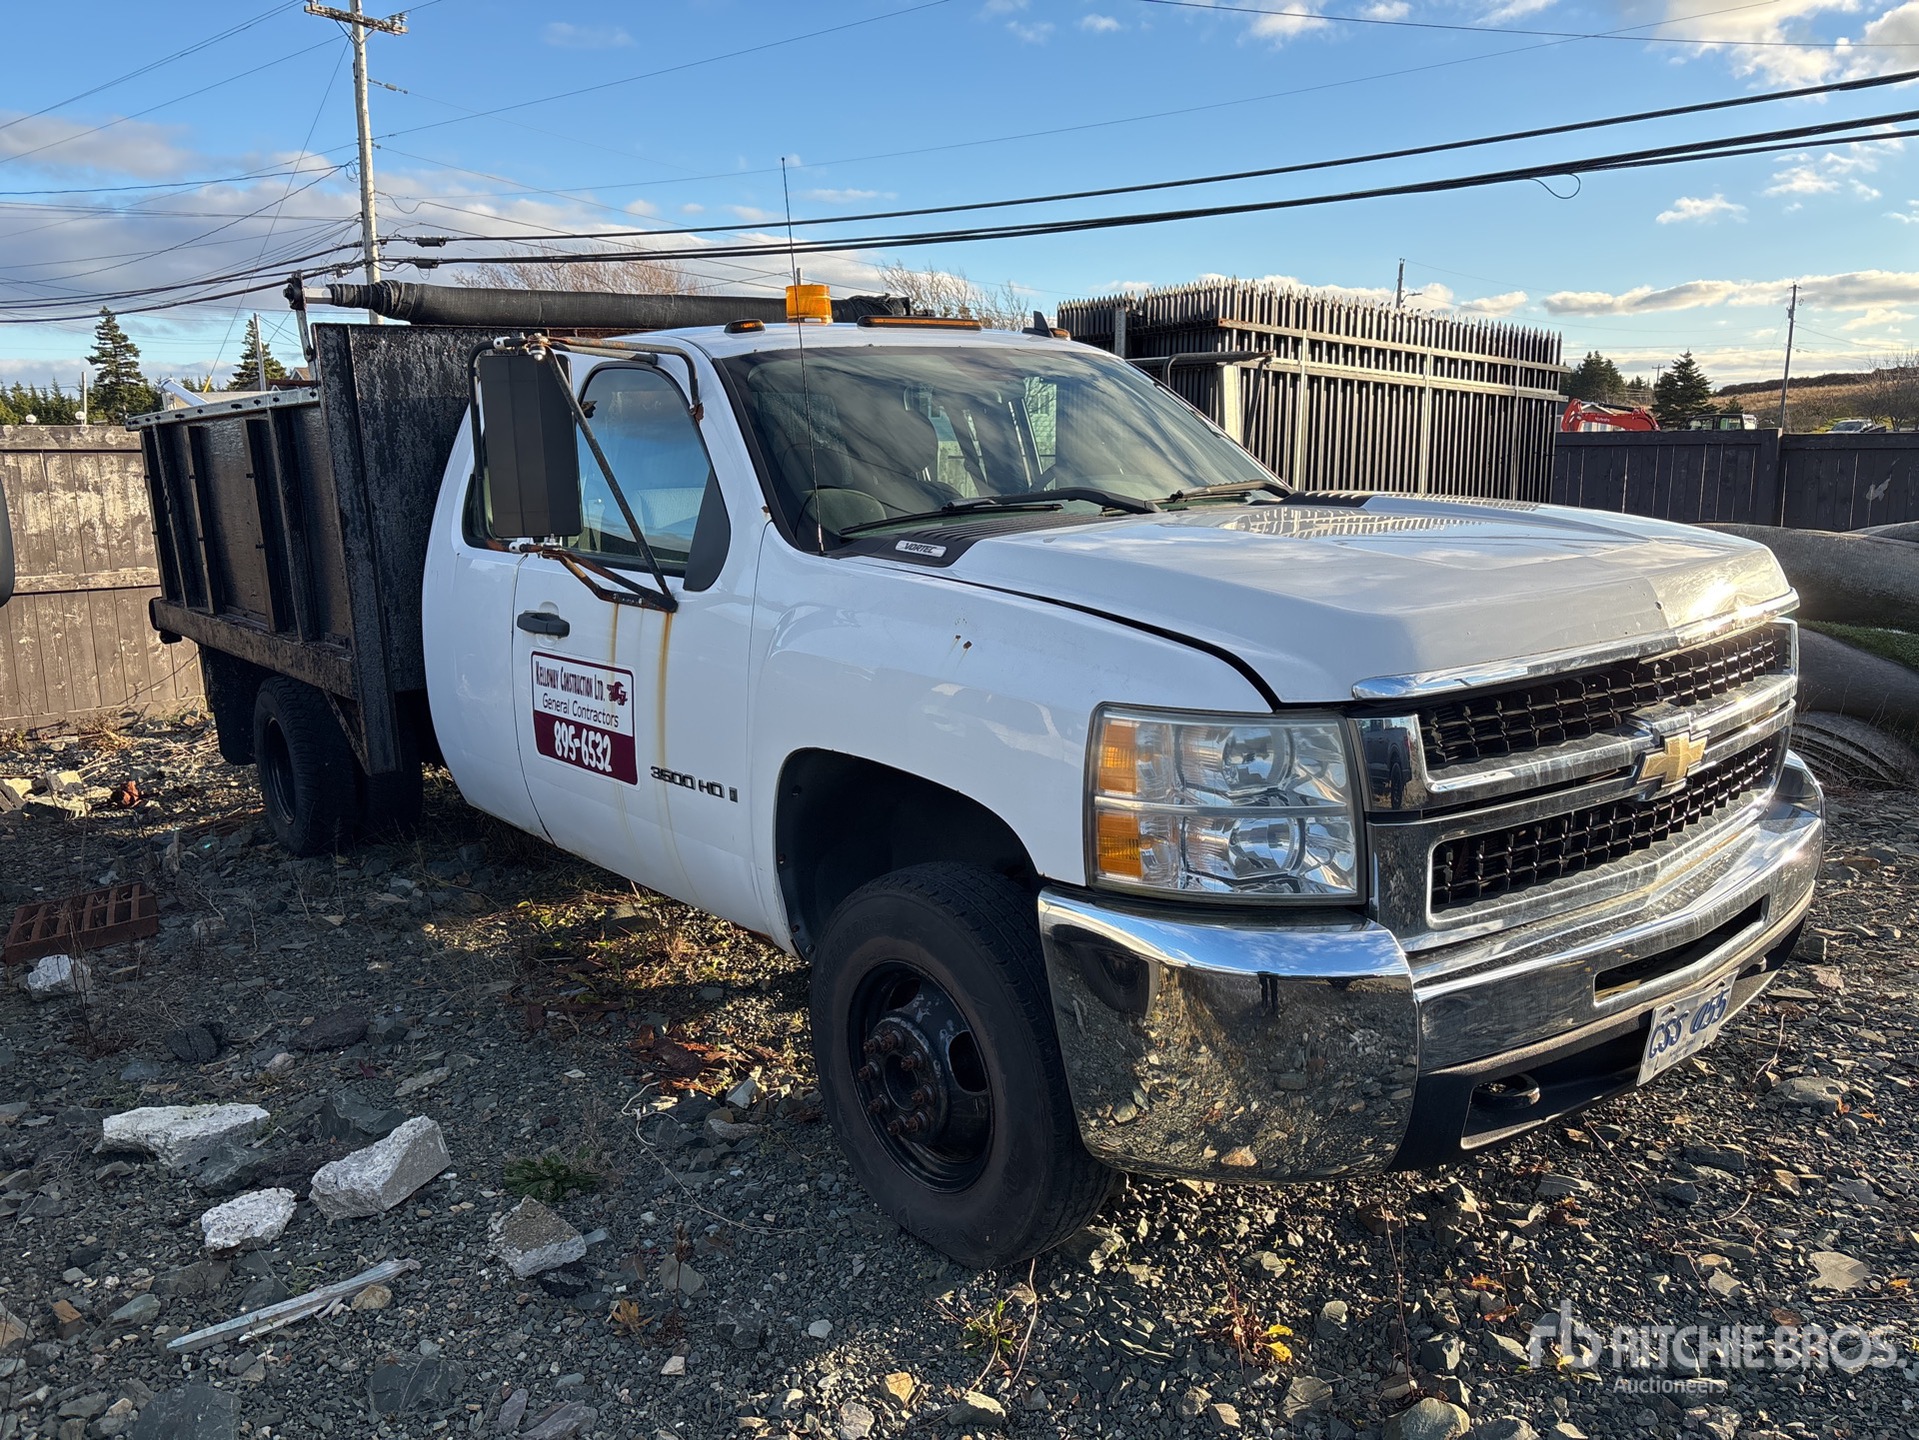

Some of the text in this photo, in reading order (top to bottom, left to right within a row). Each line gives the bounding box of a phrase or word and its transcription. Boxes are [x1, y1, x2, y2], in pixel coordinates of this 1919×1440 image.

[904, 542, 937, 554] VORTEC
[560, 666, 593, 698] CONSTRUCTION
[542, 692, 619, 728] General Contractors
[553, 719, 613, 773] 895-6532
[650, 765, 725, 799] 3500 HD
